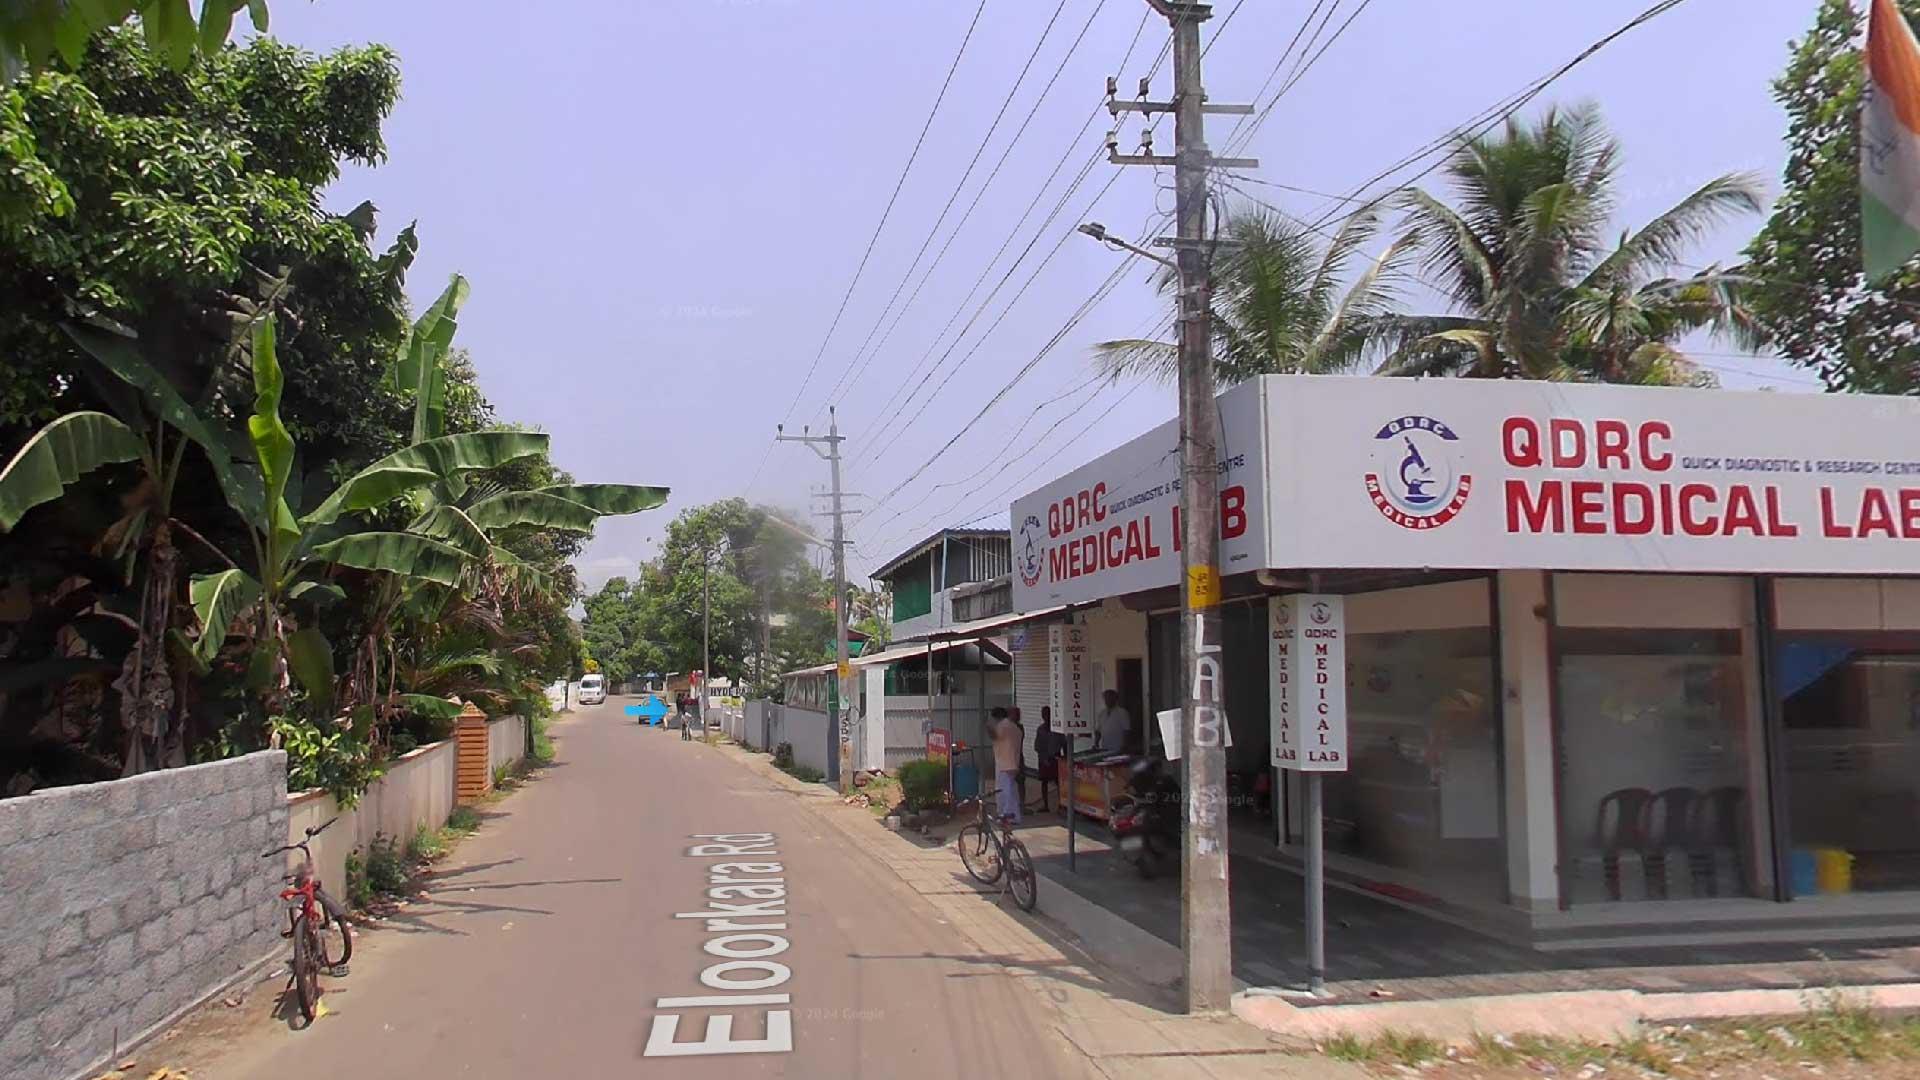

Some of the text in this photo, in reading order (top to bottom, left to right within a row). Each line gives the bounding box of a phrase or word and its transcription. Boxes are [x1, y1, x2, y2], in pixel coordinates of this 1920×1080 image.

[1389, 417, 1445, 435] QDRC
[1502, 416, 1920, 474] QDRC QUICK DIAGNOSTIC & RESEARCH CENT
[1048, 482, 1107, 538] QDRC
[1127, 486, 1164, 508] DIAGNOSTIC
[1217, 454, 1245, 475] ENTRE
[1366, 478, 1441, 529] MEDICAL
[1504, 479, 1797, 536] MEDICAL
[1050, 515, 1160, 583] MEDICAL
[1304, 628, 1337, 639] QDRC
[1193, 614, 1222, 747] LAB
[1279, 644, 1290, 744] MEDICAL
[1314, 643, 1329, 745] MEDICAL
[1275, 748, 1296, 761] LAB
[1308, 750, 1340, 763] LAB
